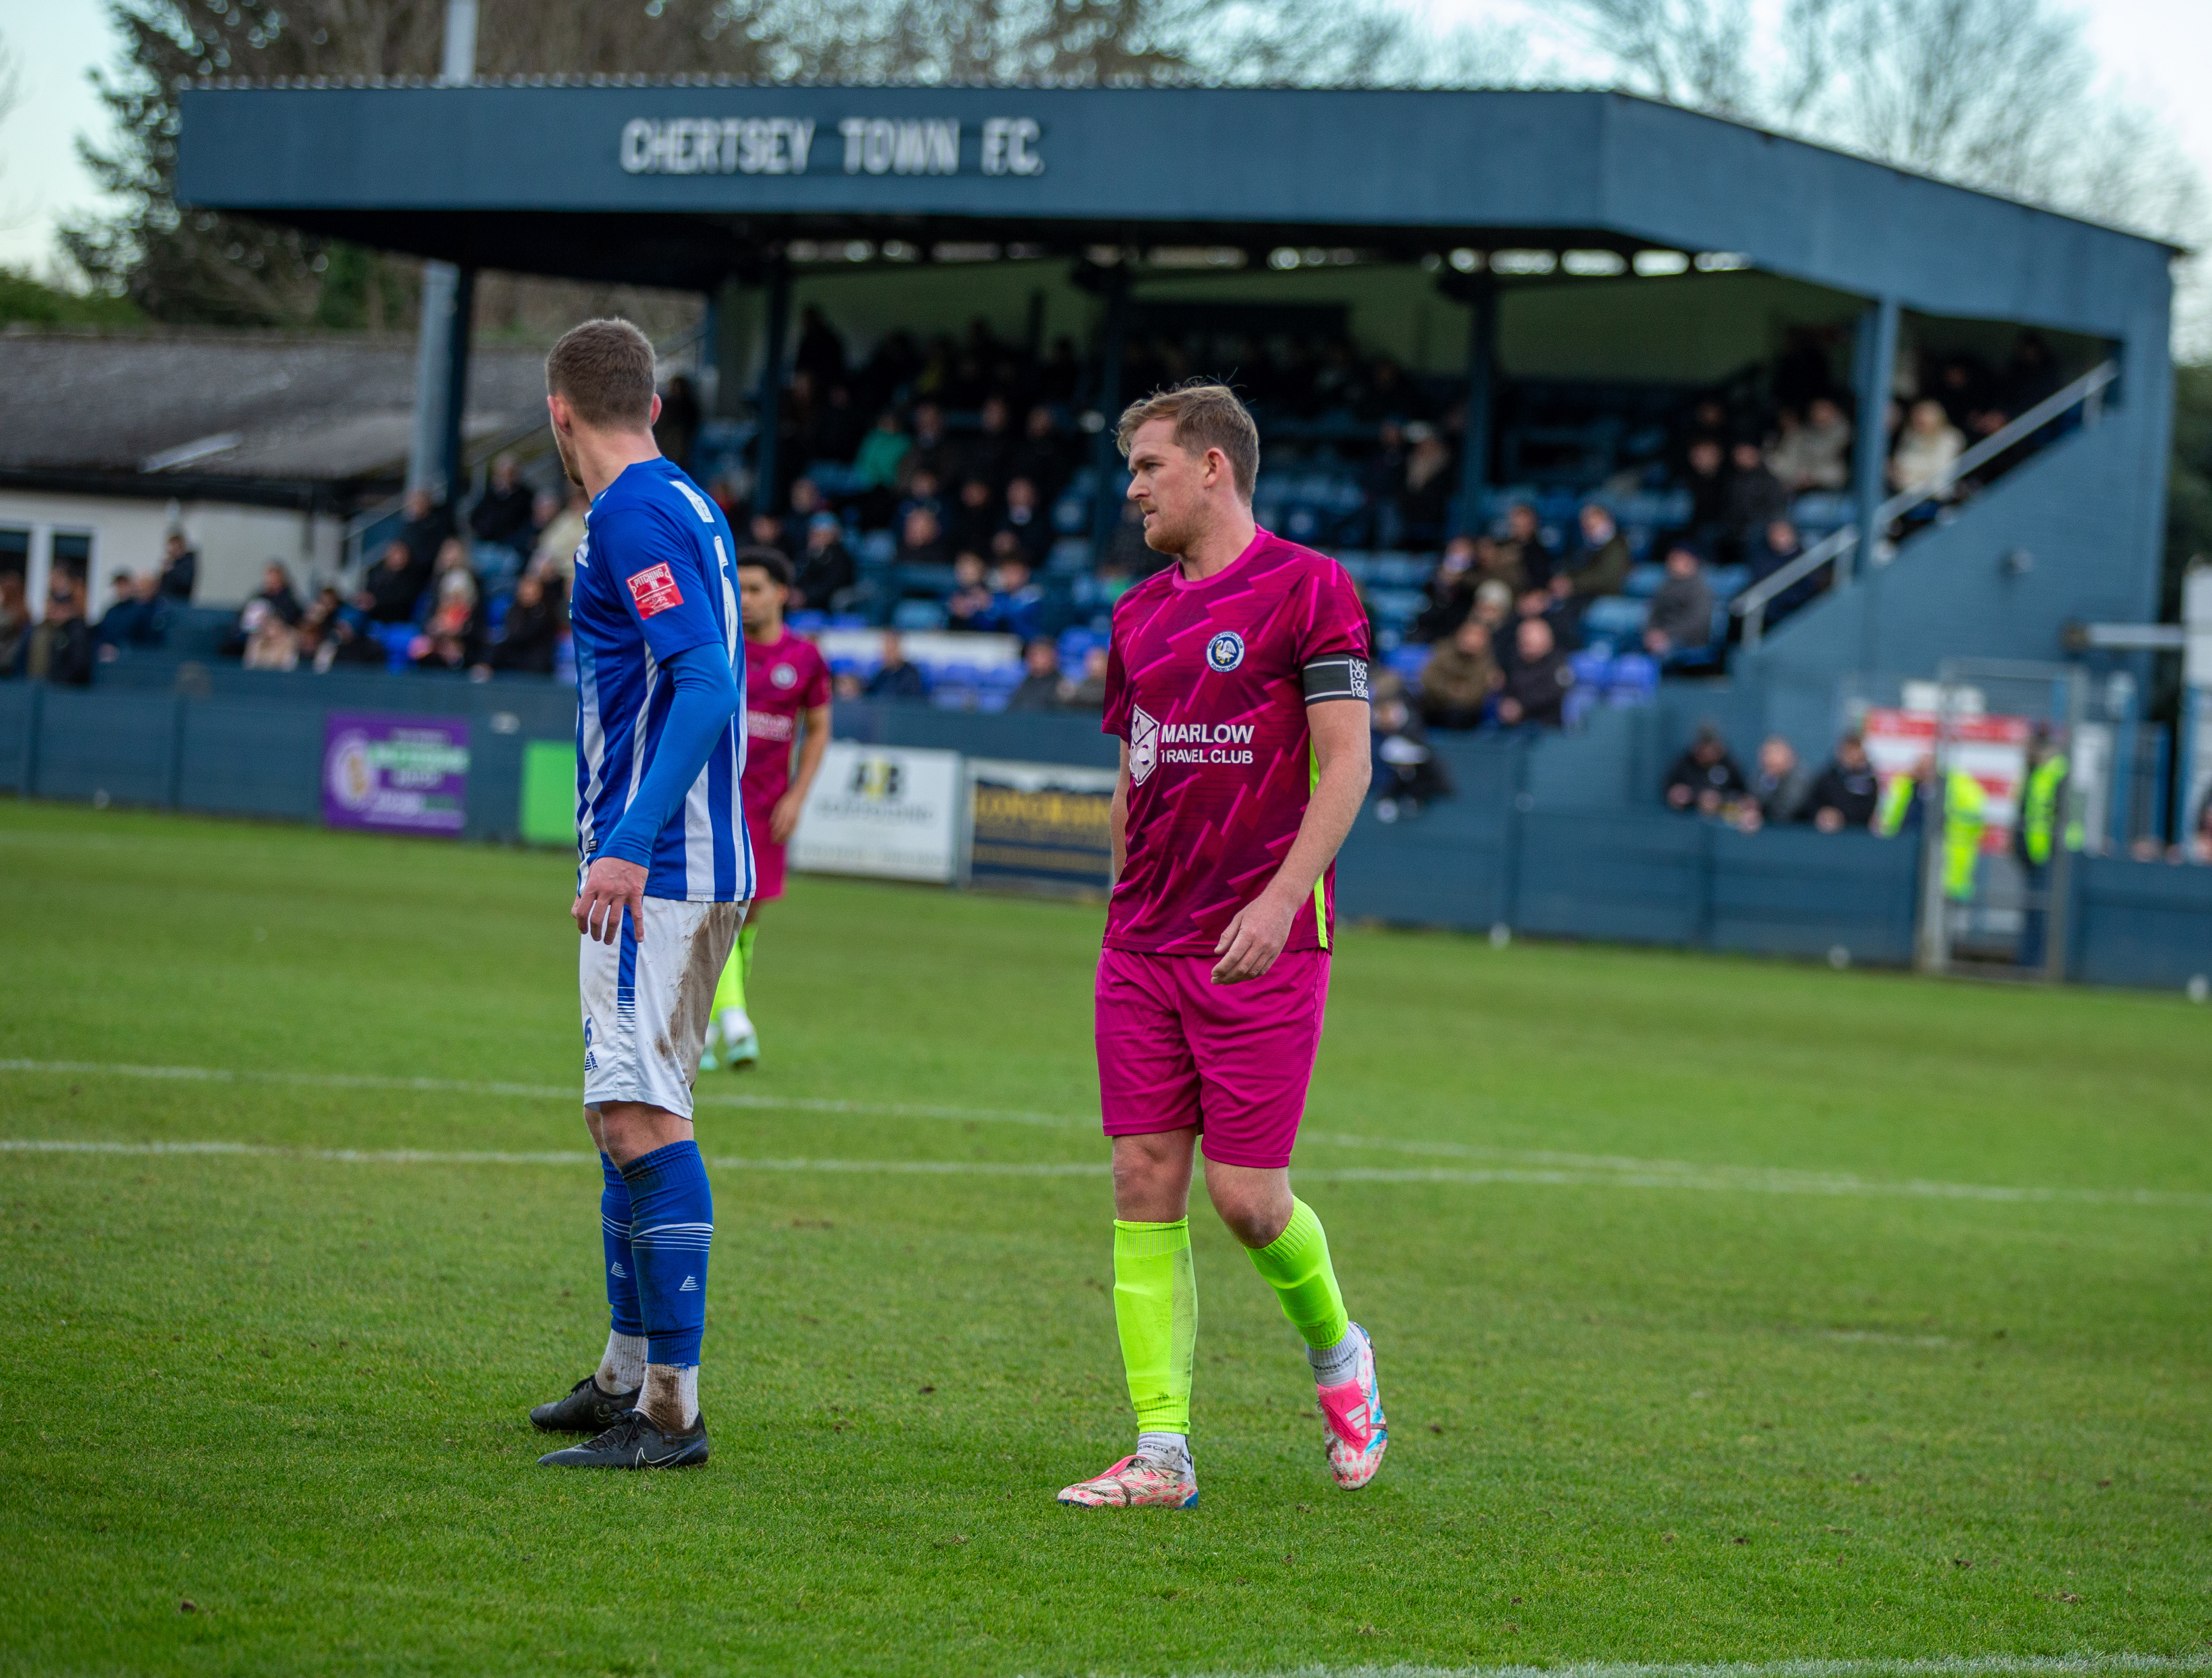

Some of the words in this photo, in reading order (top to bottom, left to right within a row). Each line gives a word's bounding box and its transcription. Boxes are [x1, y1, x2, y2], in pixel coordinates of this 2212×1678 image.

[621, 117, 816, 175] CHERTSEY
[839, 117, 960, 176] TOWN
[634, 567, 664, 588] PITCHING
[649, 578, 660, 590] IN
[660, 588, 672, 597] WITH
[1208, 635, 1221, 649] MARLOW
[1161, 724, 1255, 744] MARLOW
[1210, 750, 1254, 764] CLUB
[584, 1016, 592, 1049] 6
